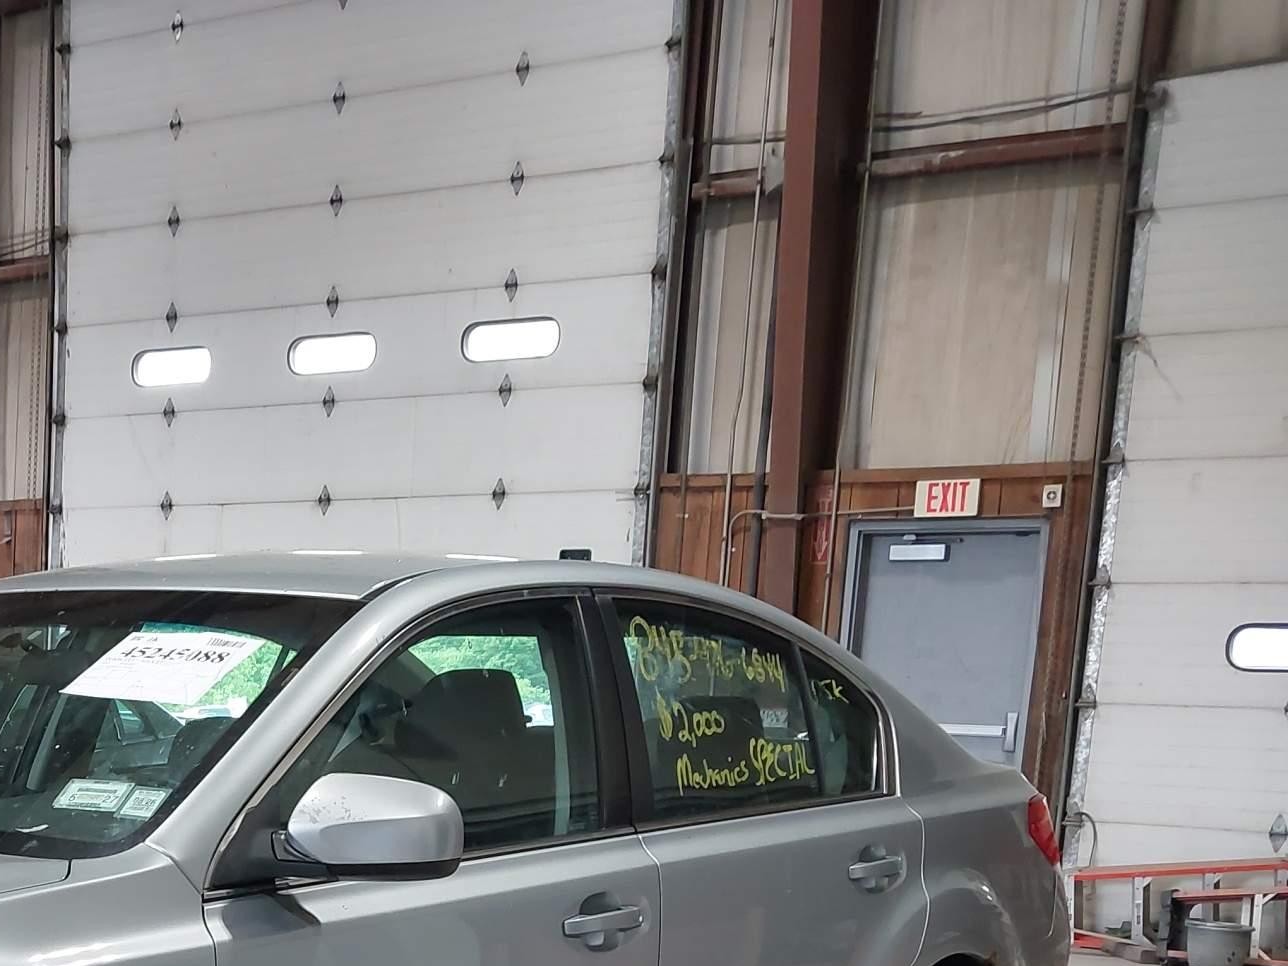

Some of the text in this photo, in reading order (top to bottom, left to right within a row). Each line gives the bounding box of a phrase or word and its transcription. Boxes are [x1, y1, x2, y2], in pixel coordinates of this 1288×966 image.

[926, 482, 970, 513] EXIT
[120, 646, 231, 663] 45245088
[676, 737, 815, 797] Mechanics SPECIAL
